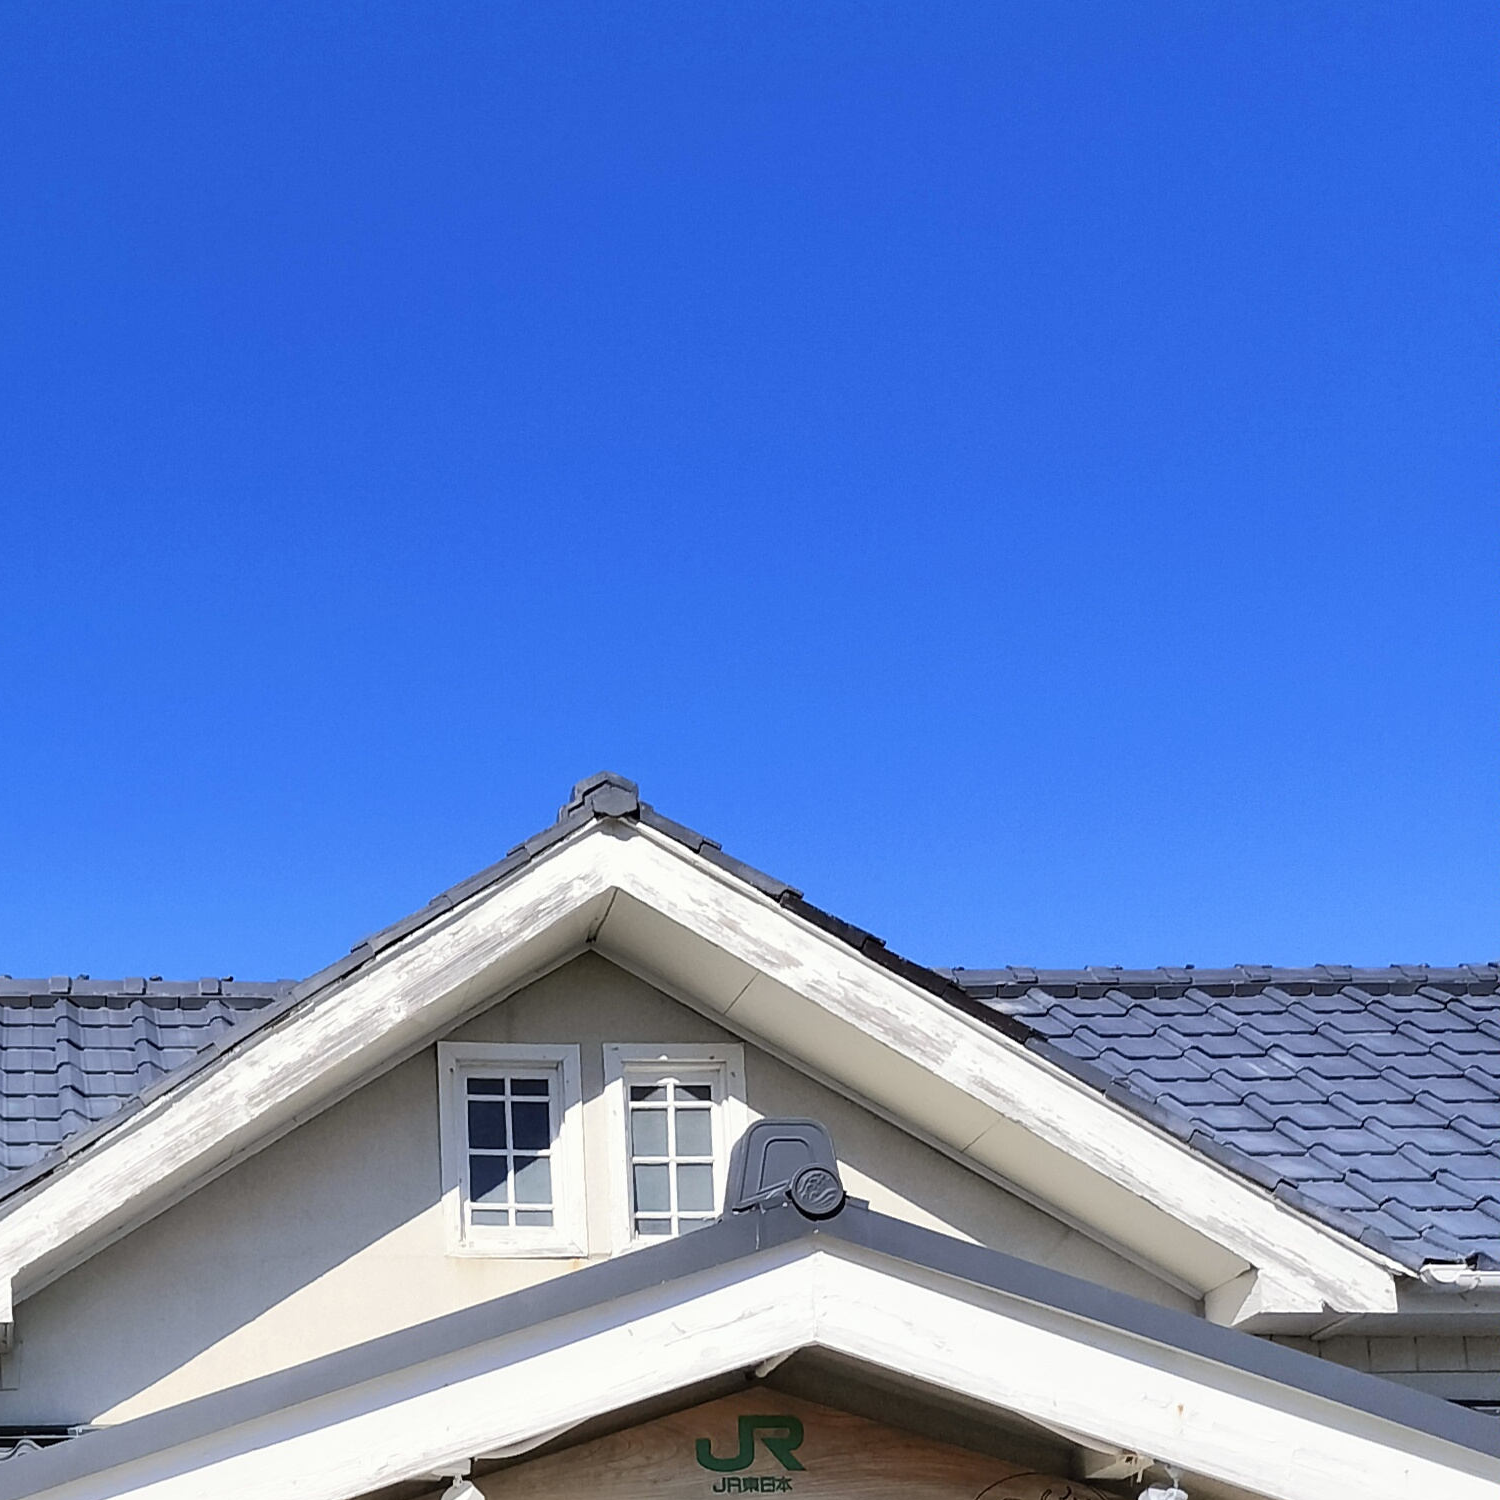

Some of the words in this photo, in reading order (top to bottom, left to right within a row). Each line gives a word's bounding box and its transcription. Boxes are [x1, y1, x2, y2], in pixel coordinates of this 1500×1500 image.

[695, 1414, 807, 1472] JR
[712, 1476, 793, 1493] JR東日本
